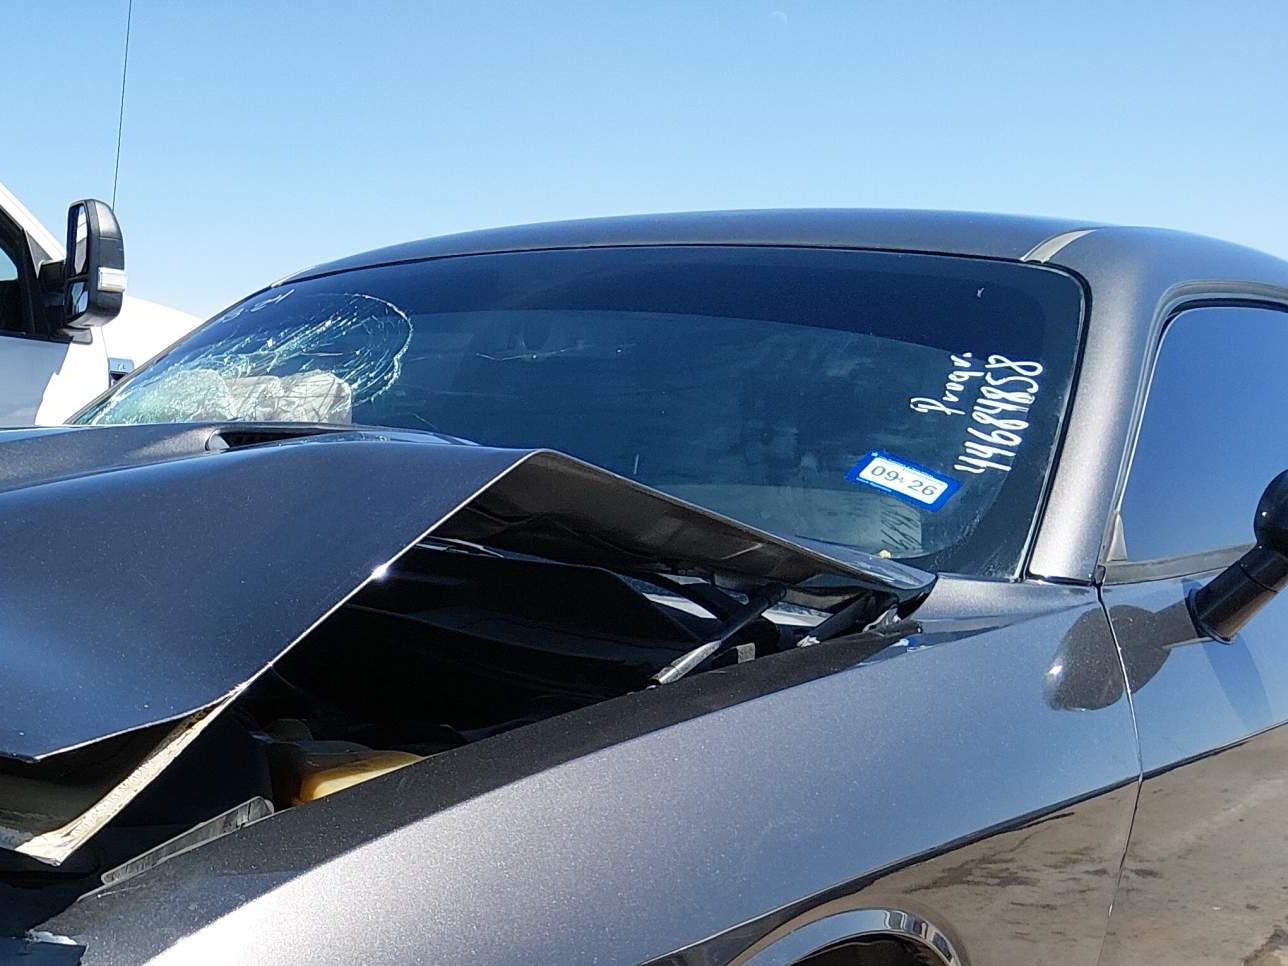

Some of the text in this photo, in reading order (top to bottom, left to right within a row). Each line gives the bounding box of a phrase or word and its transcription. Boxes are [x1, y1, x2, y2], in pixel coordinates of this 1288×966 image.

[954, 354, 1043, 474] 44684858
[871, 465, 899, 482] 09
[907, 479, 938, 496] 26
